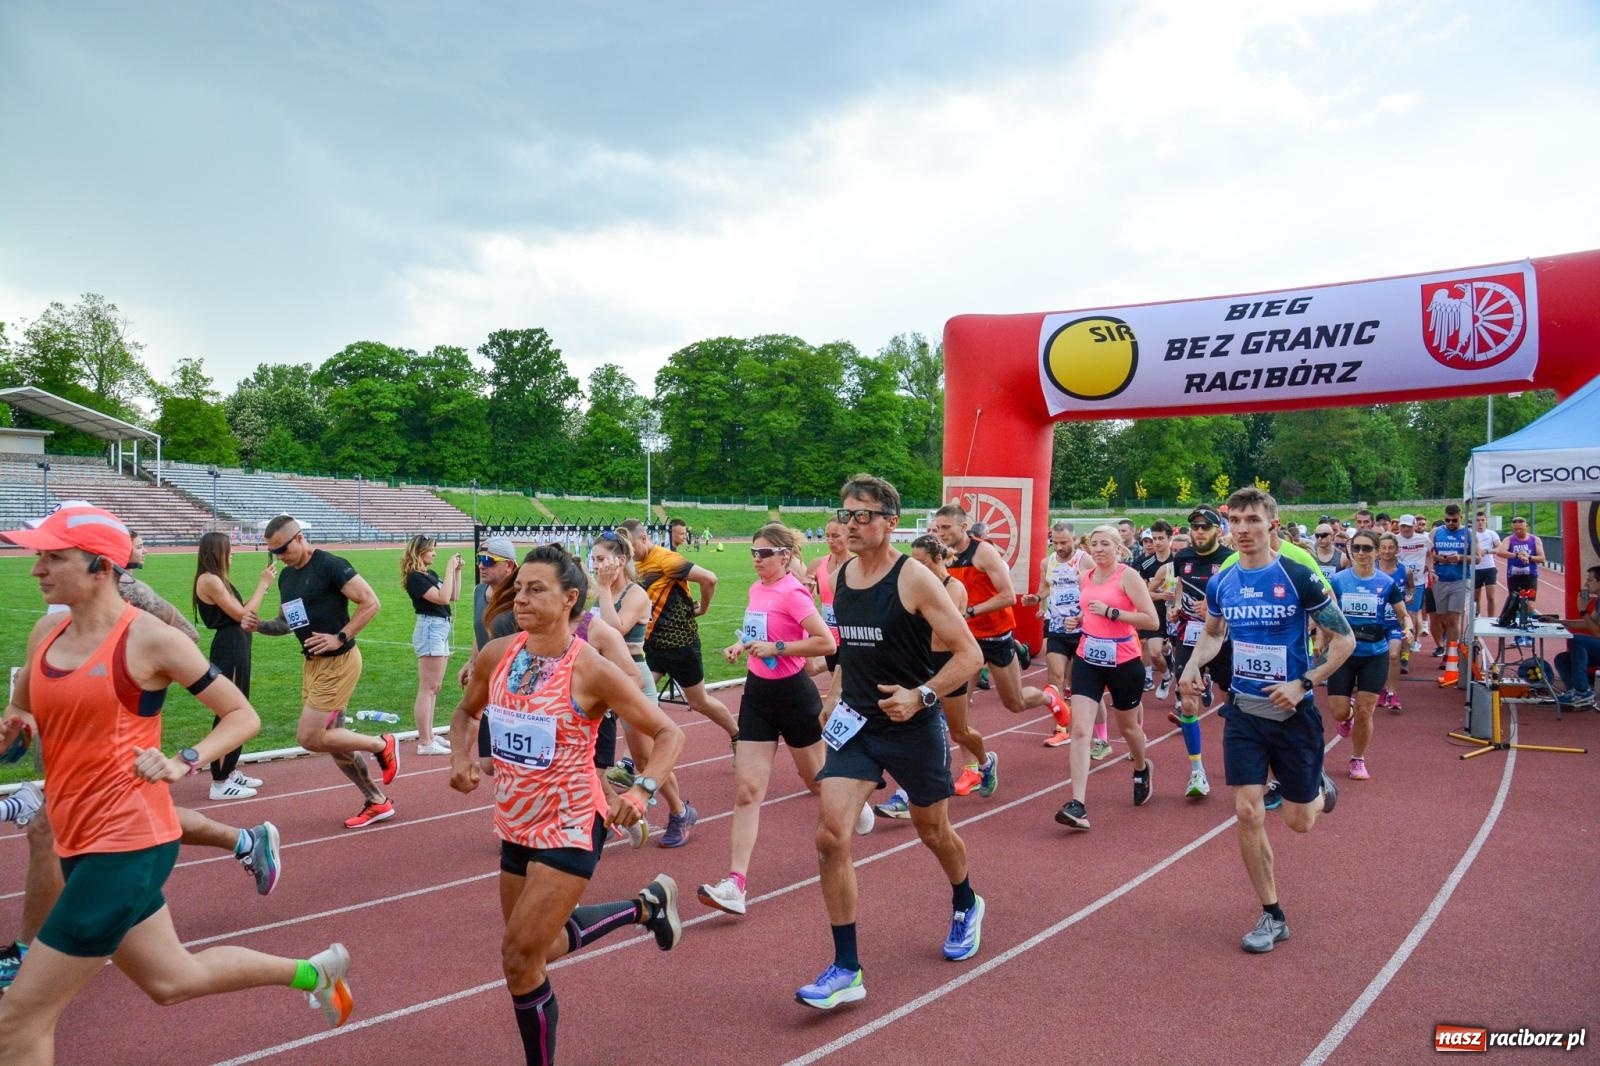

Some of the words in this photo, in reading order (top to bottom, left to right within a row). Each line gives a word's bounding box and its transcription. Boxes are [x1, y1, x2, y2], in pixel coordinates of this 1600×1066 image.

[1224, 296, 1313, 321] BIEG
[1089, 324, 1136, 343] SIR
[1163, 334, 1235, 361] BEZ
[1240, 320, 1380, 355] GRANIC
[1184, 358, 1363, 393] RACIBÓRZ
[1060, 593, 1075, 602] 255
[1220, 604, 1297, 620] UNNERS
[1350, 602, 1368, 611] 180
[1089, 647, 1107, 660] 229
[1246, 658, 1271, 673] 183
[527, 714, 551, 723] GRANIC
[830, 719, 850, 738] 187
[504, 731, 532, 753] 151
